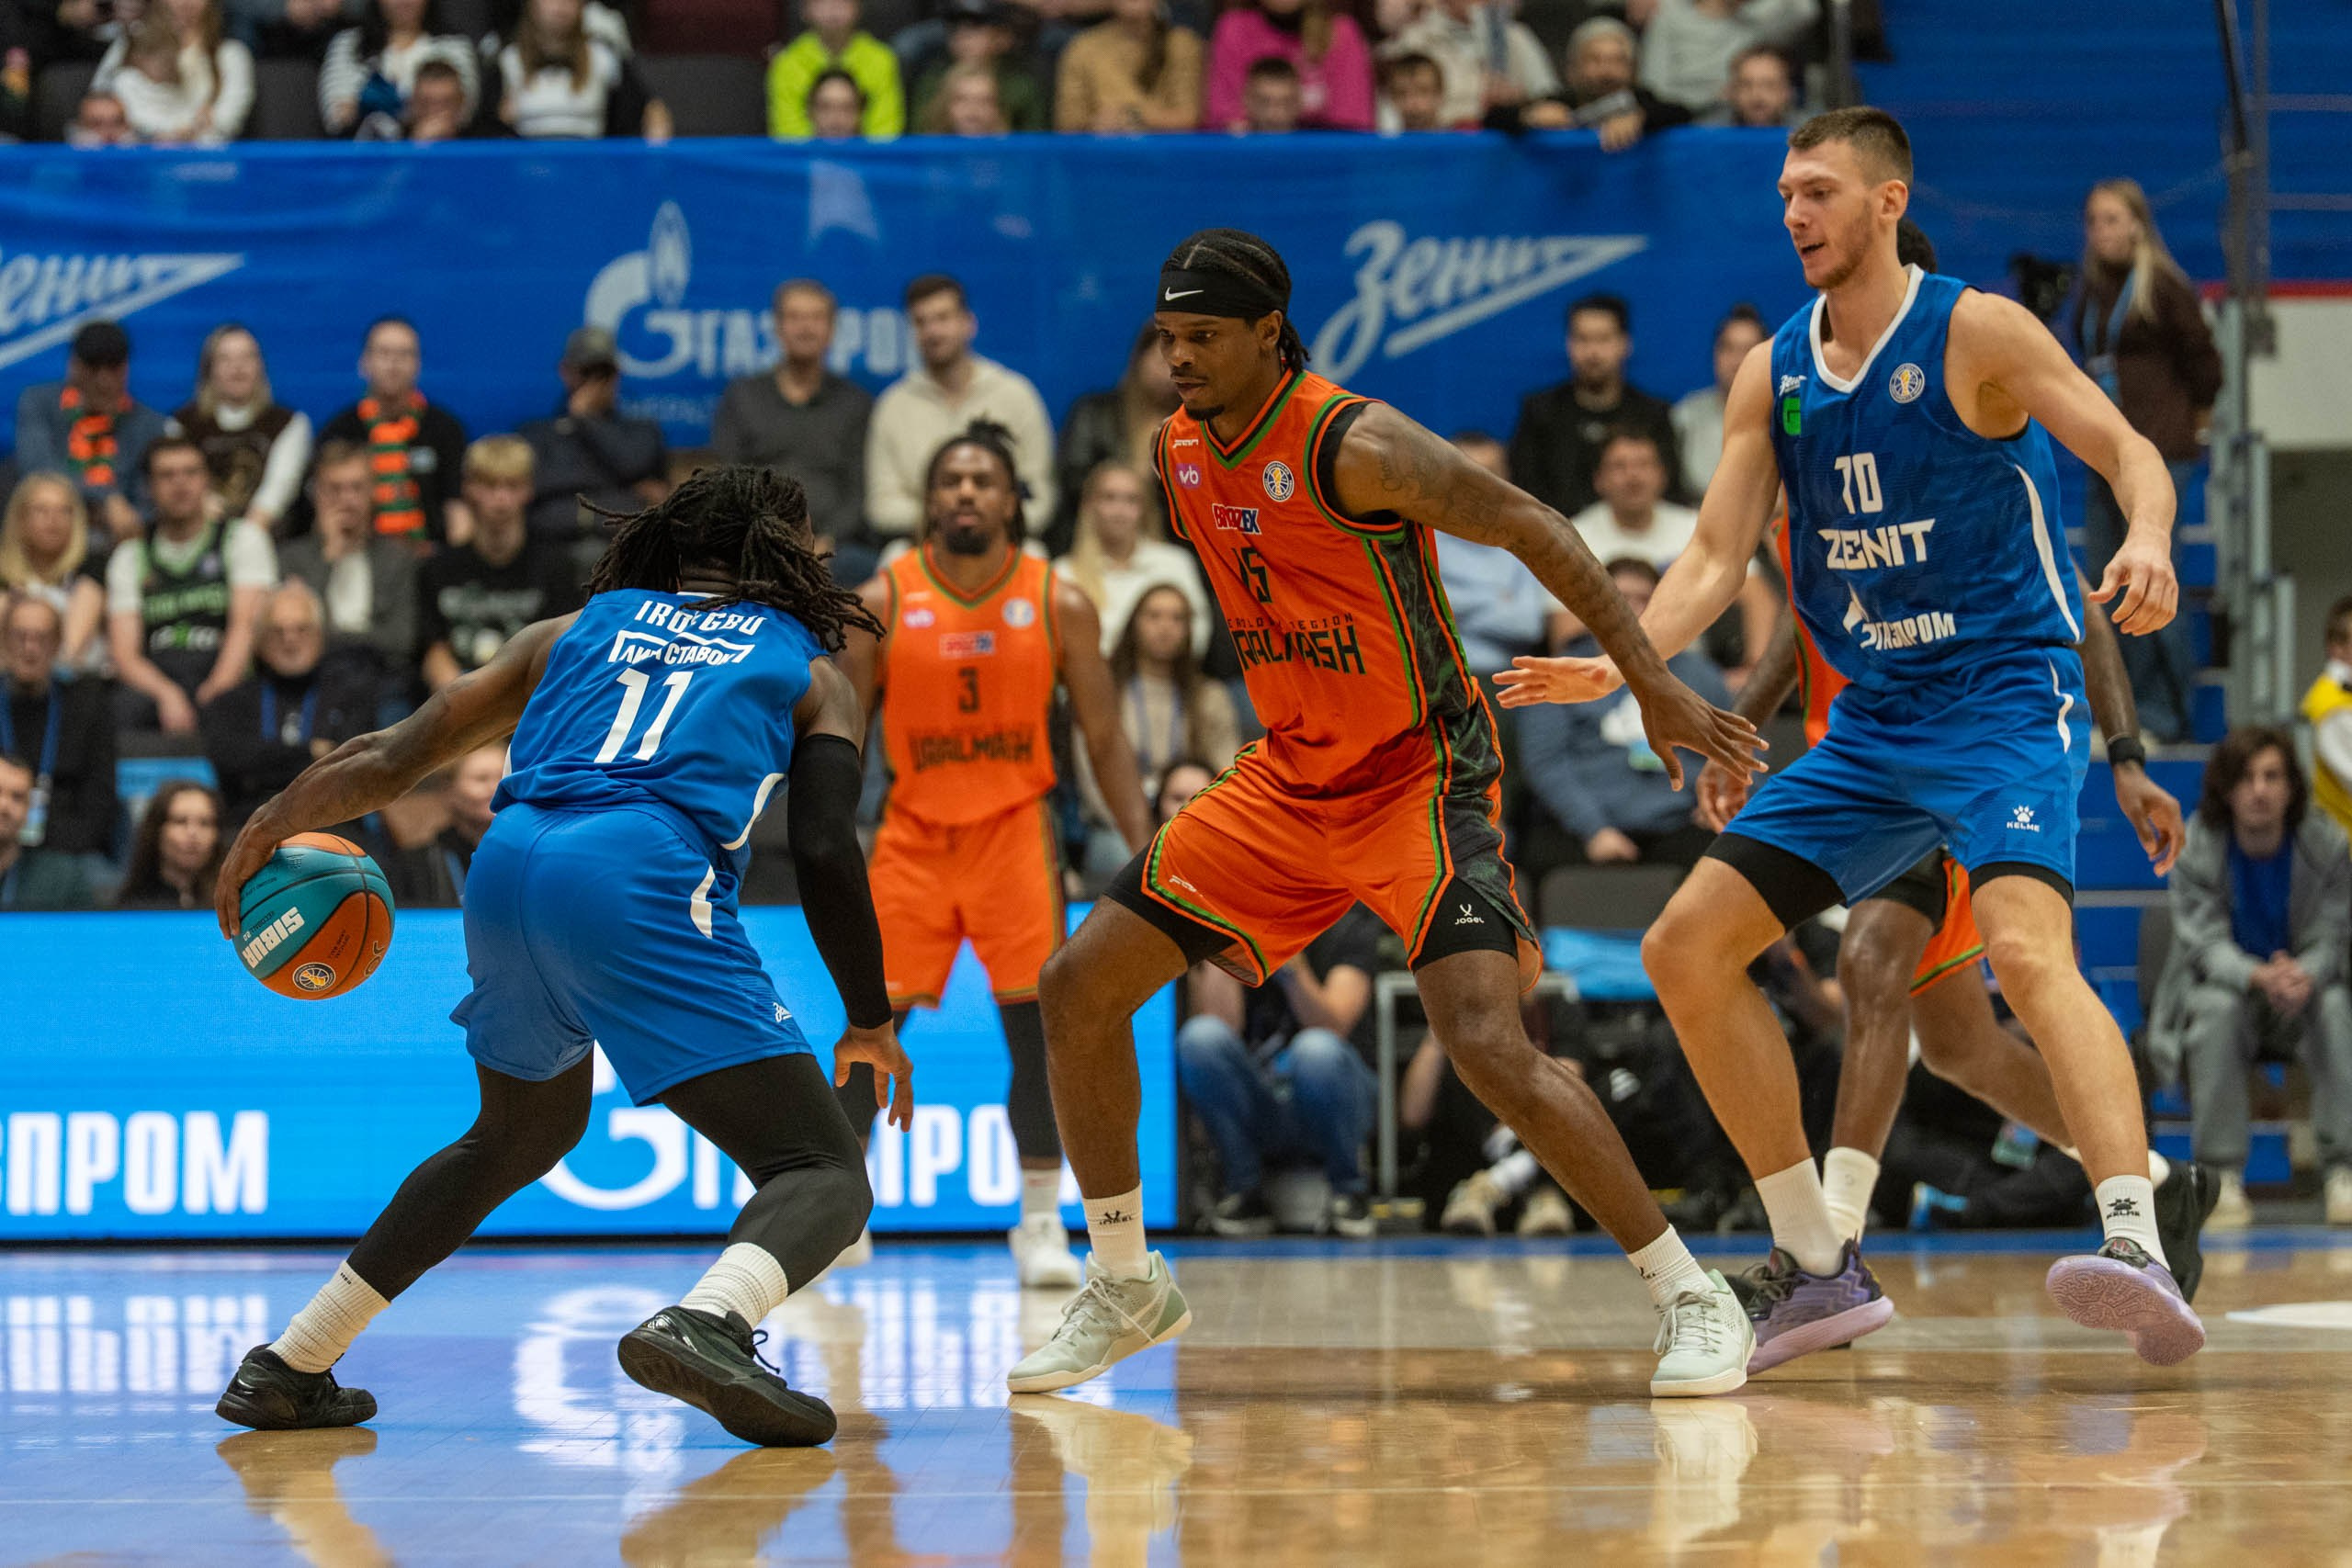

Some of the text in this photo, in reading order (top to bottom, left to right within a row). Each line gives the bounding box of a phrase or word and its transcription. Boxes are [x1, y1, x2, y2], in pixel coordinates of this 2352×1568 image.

[1835, 452, 1883, 514] 10
[1817, 518, 1936, 570] ZENIT
[634, 600, 767, 636] IROGBU
[1231, 625, 1367, 674] RALASH
[594, 667, 694, 763] 11
[958, 666, 981, 714] 3
[2006, 820, 2041, 833] KELME
[242, 906, 305, 969] SIBUR
[0, 1110, 269, 1216] ПРОМ
